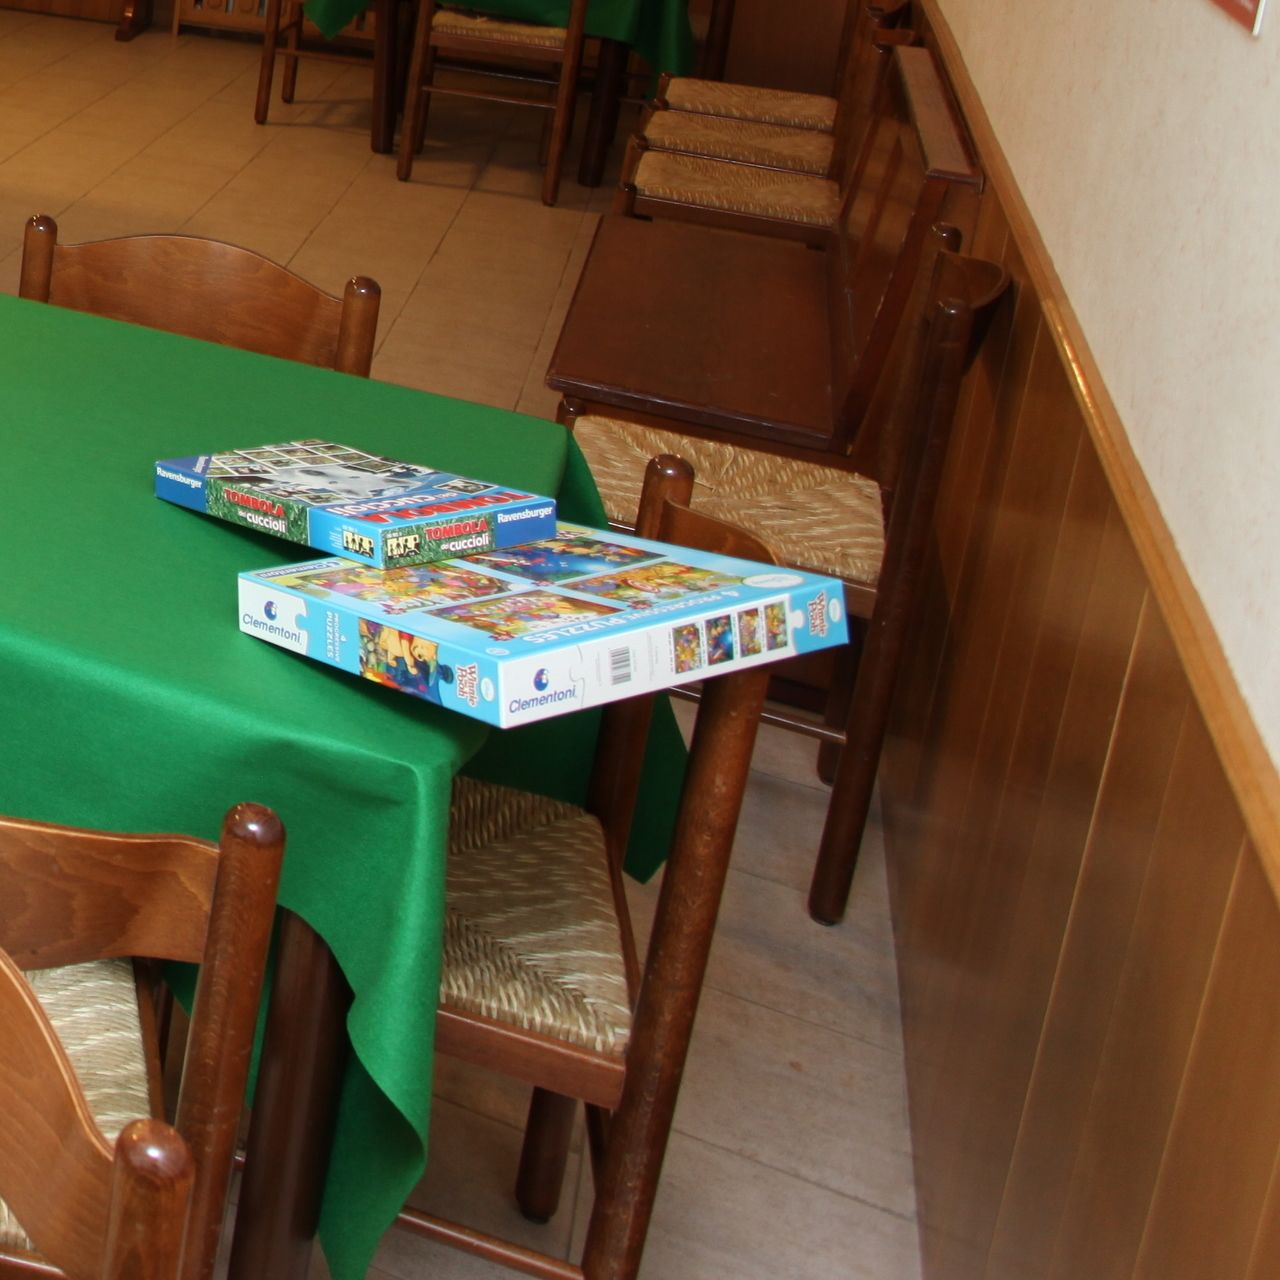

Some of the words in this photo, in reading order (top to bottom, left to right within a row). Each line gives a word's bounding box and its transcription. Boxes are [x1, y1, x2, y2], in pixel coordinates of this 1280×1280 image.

[156, 466, 203, 489] Ravensburger
[224, 488, 285, 517] TOMBOLA
[497, 506, 553, 524] Ravensburger
[246, 512, 286, 533] cuccioli
[424, 518, 488, 541] TOMBOLA
[450, 535, 489, 552] cuccioli
[242, 613, 301, 643] Clementoni
[522, 616, 629, 644] PUZZLES
[457, 666, 468, 697] Pooh
[468, 664, 477, 705] Winnie
[509, 685, 576, 713] Clementoni
